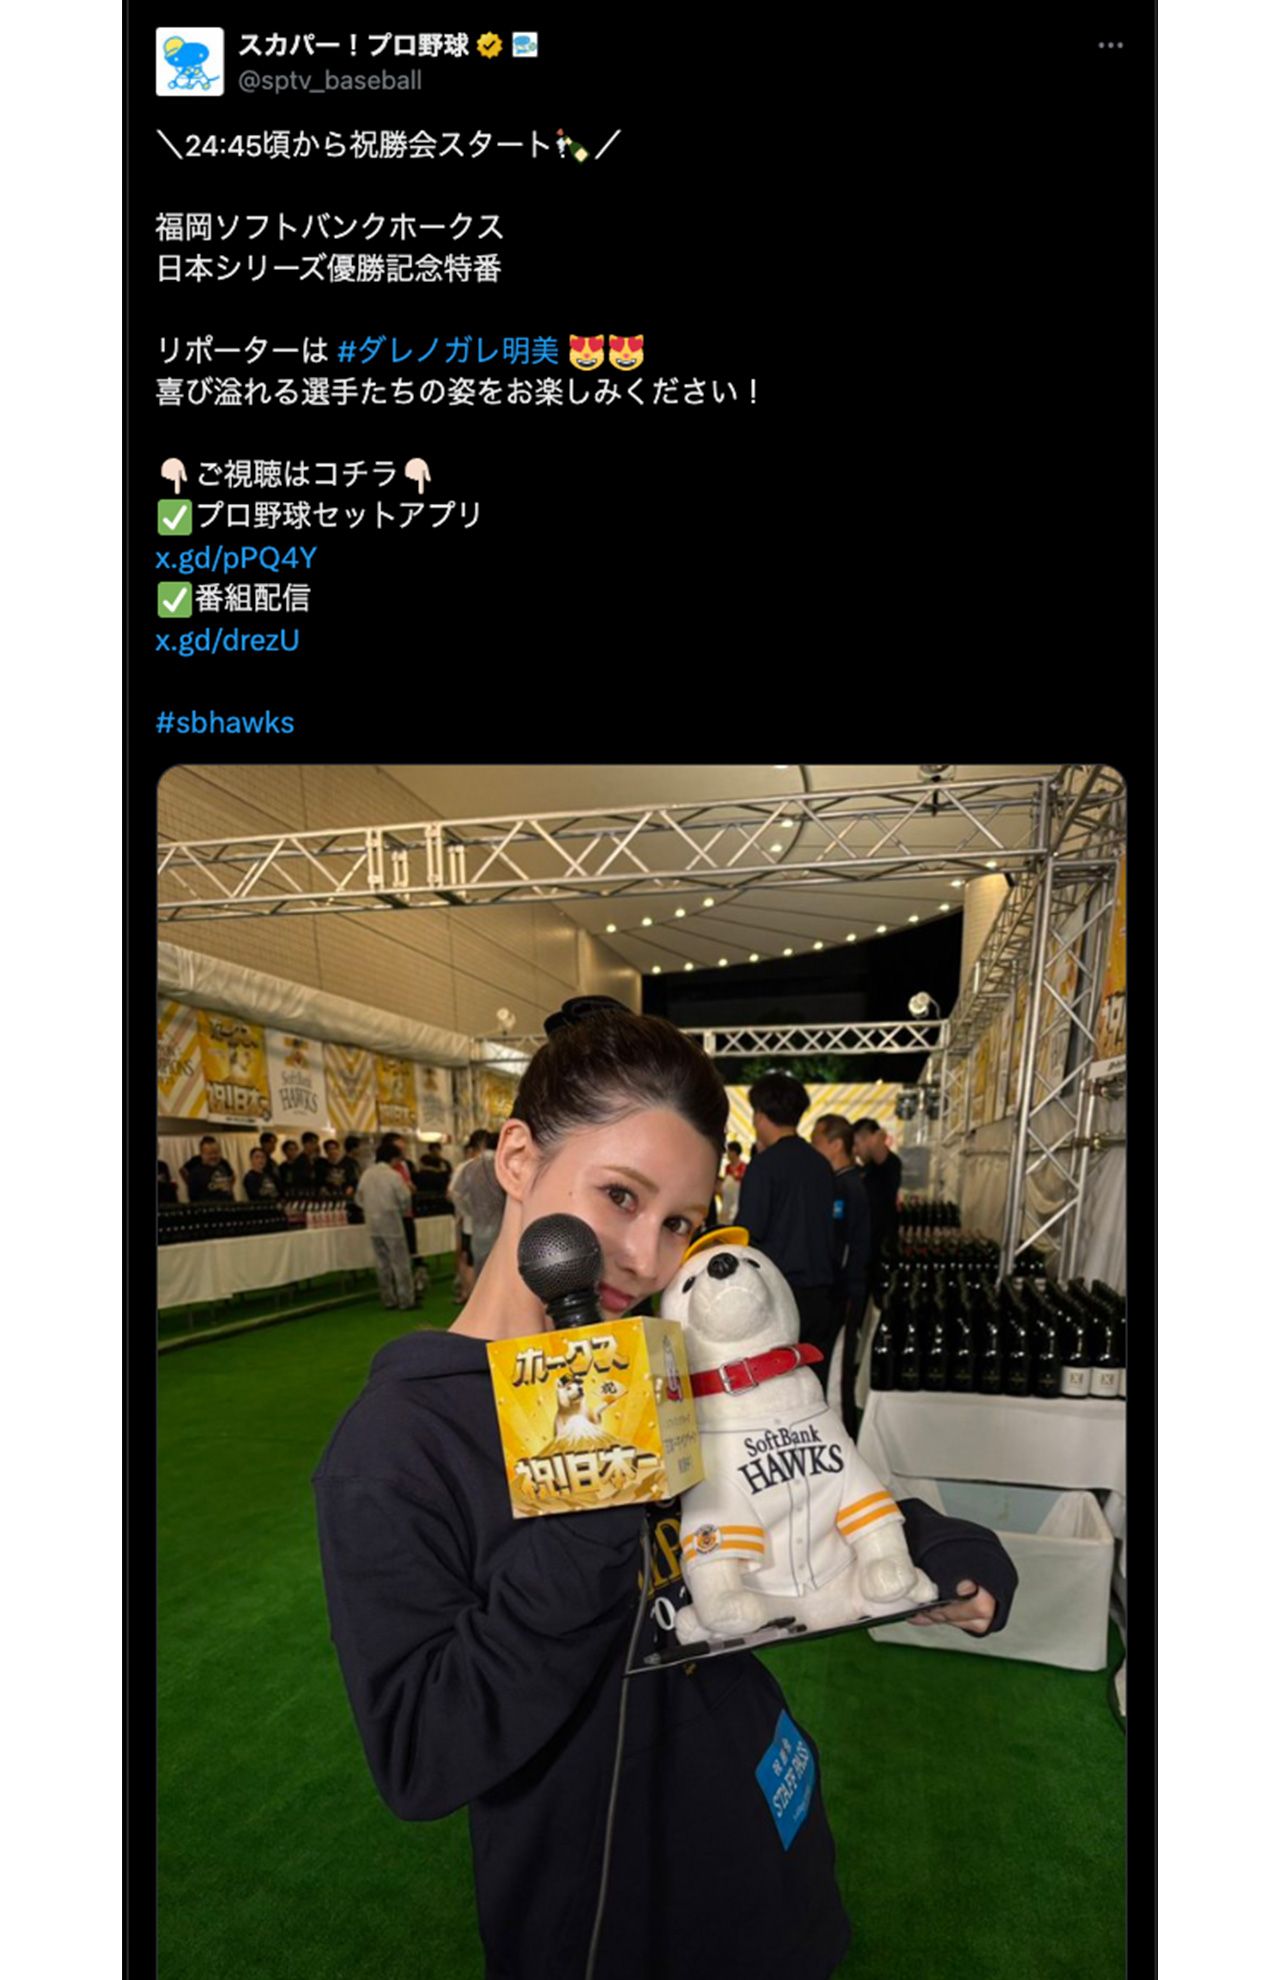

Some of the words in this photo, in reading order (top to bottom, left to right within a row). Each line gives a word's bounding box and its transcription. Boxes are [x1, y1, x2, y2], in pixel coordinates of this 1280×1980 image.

[512, 1333, 631, 1388] ホークス
[743, 1424, 822, 1457] SoftBank
[738, 1444, 845, 1495] HAWKS
